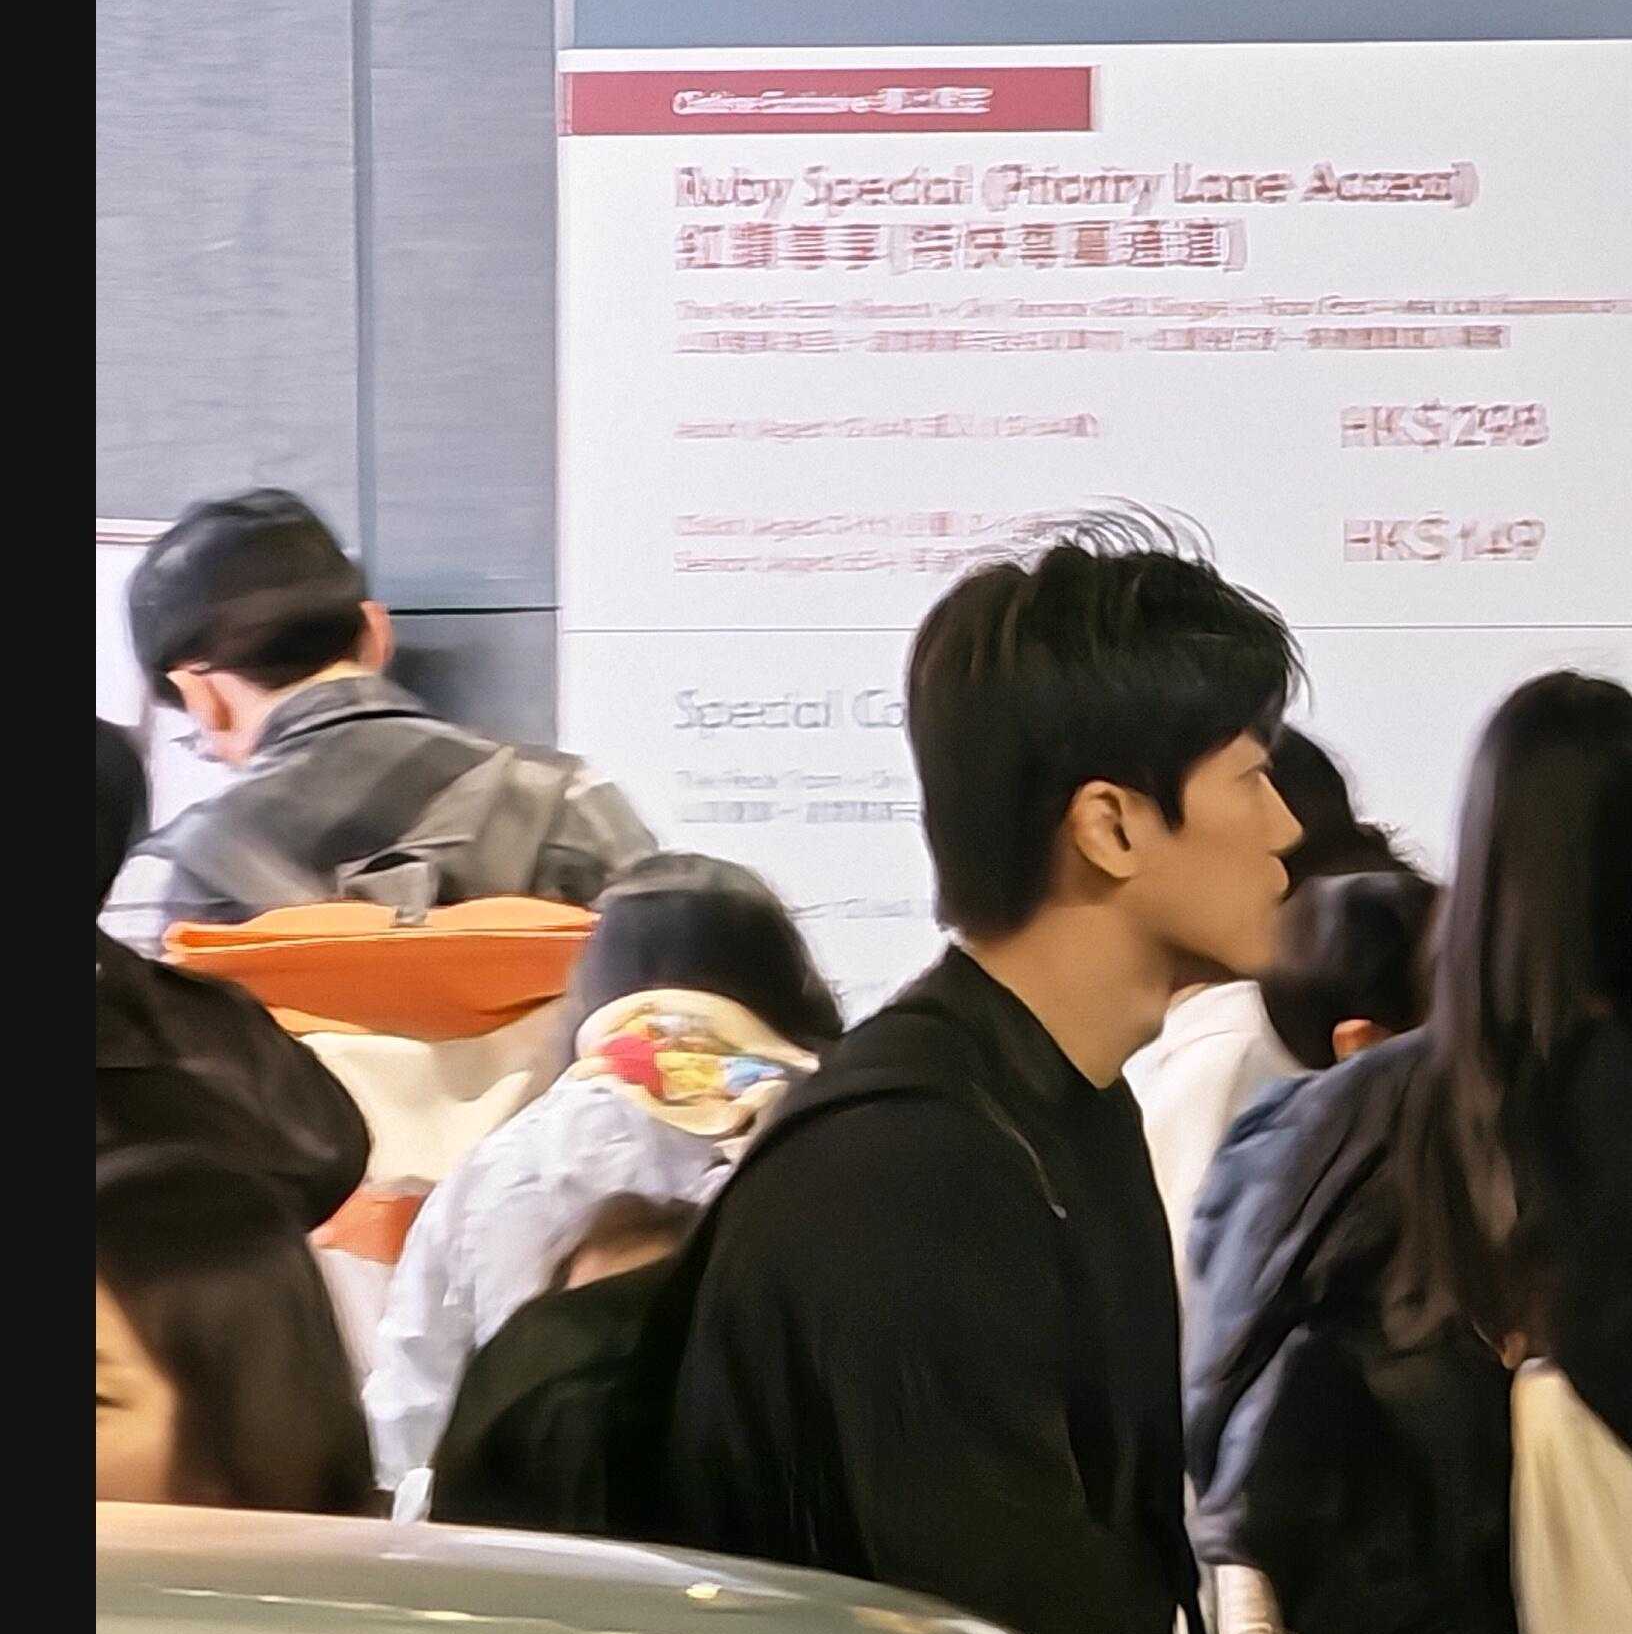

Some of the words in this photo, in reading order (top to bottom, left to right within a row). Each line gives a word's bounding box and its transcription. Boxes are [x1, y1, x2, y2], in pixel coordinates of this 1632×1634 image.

[675, 165, 794, 218] Ruby
[800, 165, 973, 218] Special
[1173, 162, 1297, 204] Lane
[1341, 399, 1549, 452] HK$298
[672, 688, 842, 739] Special
